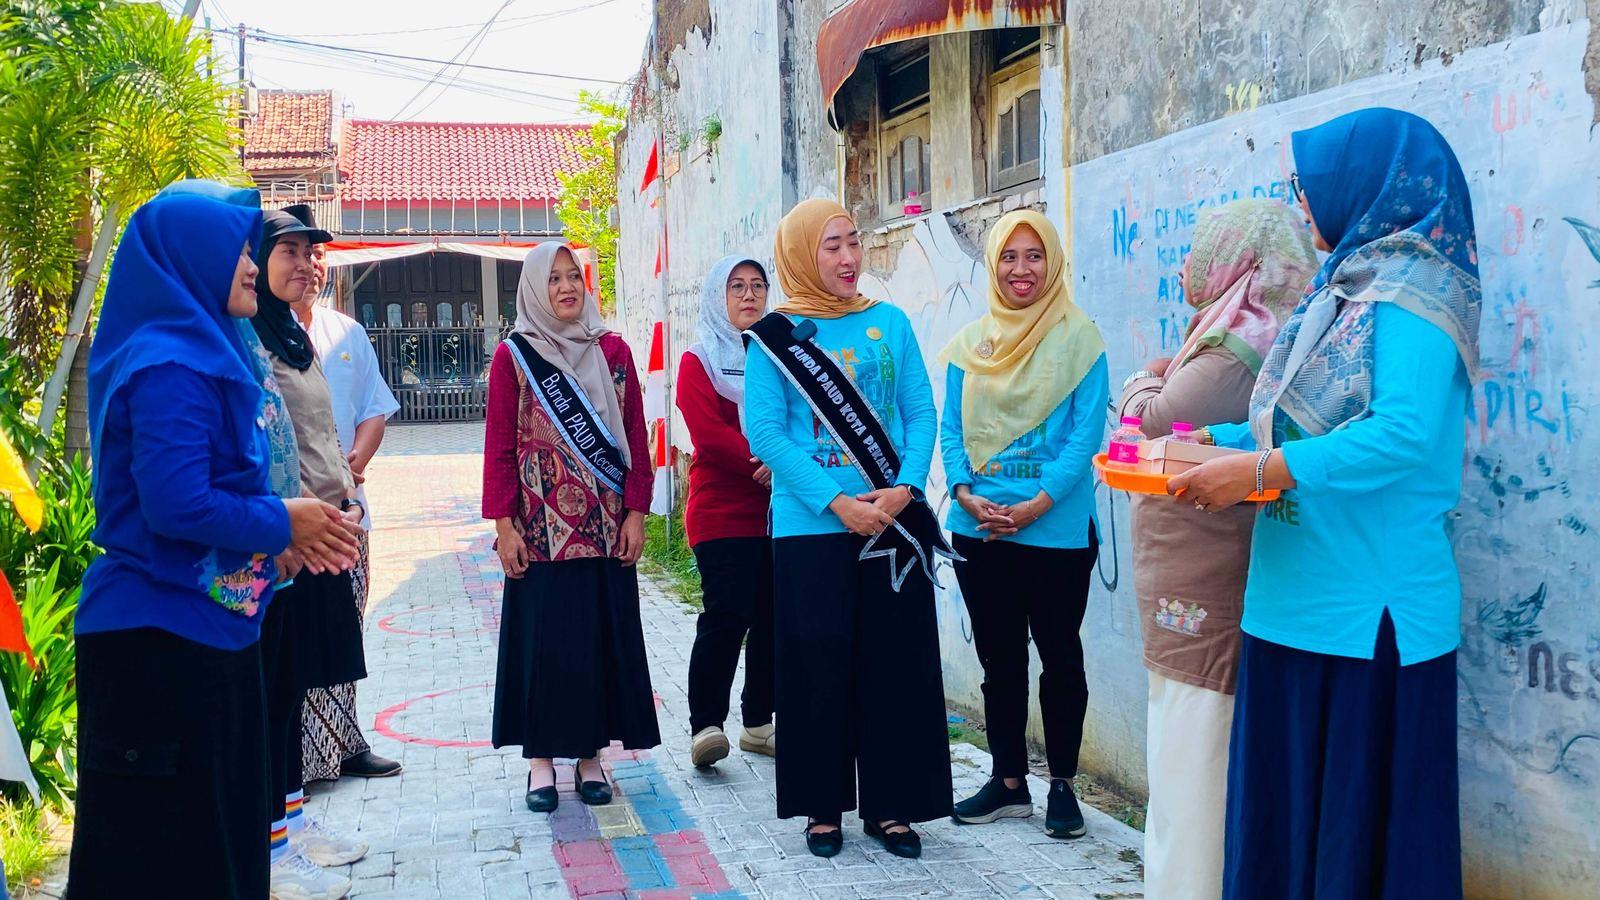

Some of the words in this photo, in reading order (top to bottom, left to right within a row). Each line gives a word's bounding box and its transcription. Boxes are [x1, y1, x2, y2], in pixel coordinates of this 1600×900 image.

[541, 372, 573, 413] Bunda
[564, 412, 596, 450] PAUD
[788, 344, 822, 376] BUNDA
[816, 371, 844, 405] PAUD
[839, 402, 867, 437] KOTA
